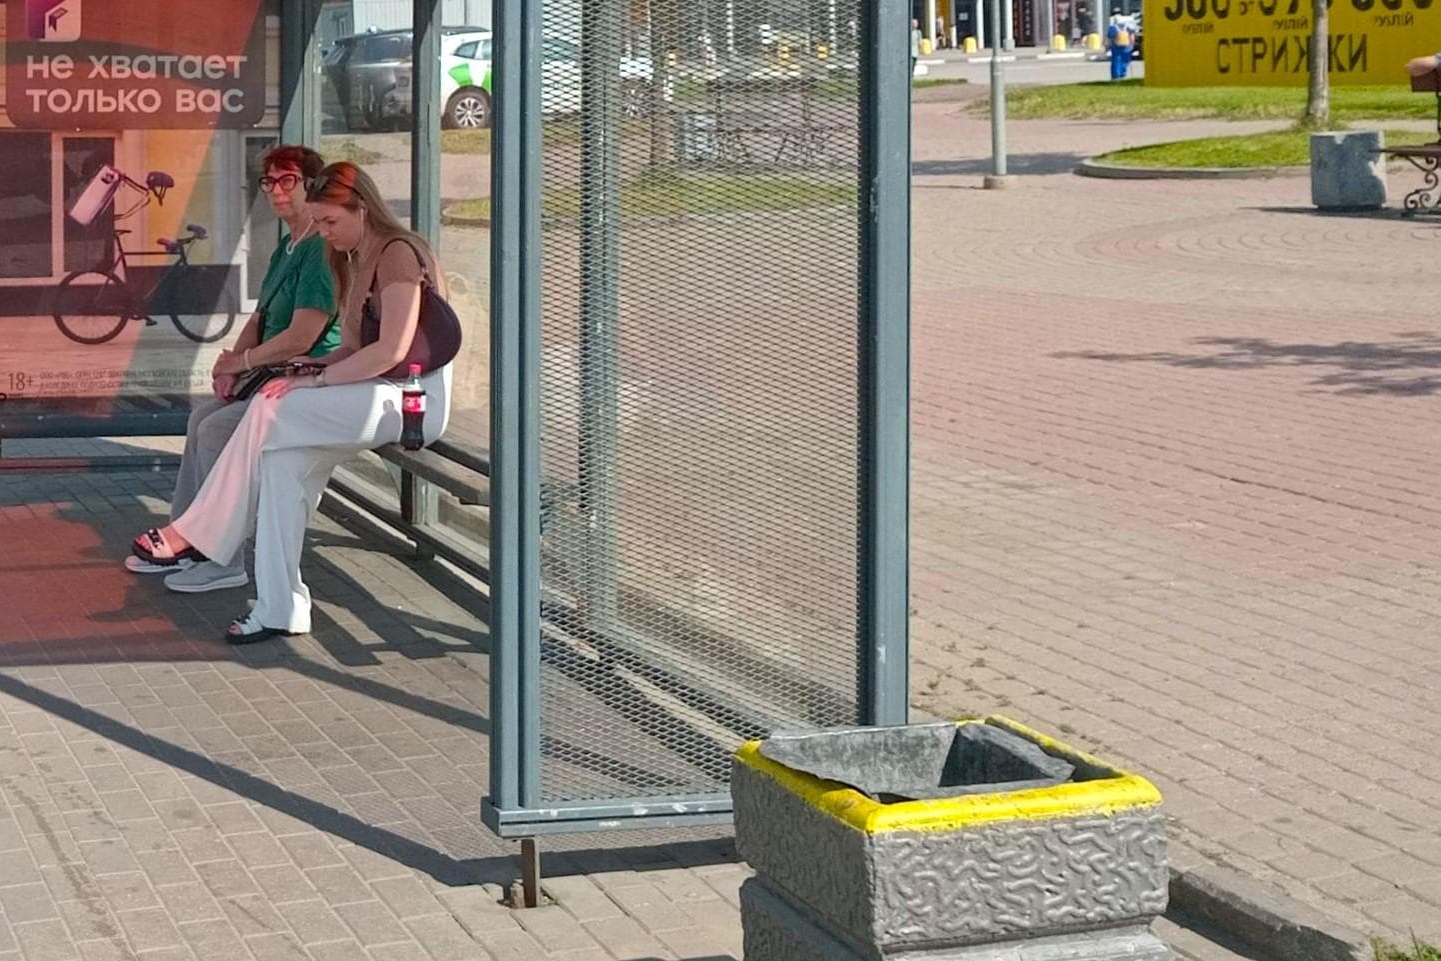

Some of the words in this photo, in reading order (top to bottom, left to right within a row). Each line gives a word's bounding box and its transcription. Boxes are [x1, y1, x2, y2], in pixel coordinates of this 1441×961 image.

[26, 54, 75, 79] не
[87, 54, 248, 79] хватает
[26, 88, 162, 113] только
[176, 88, 244, 113] вас
[8, 372, 34, 391] 18+
